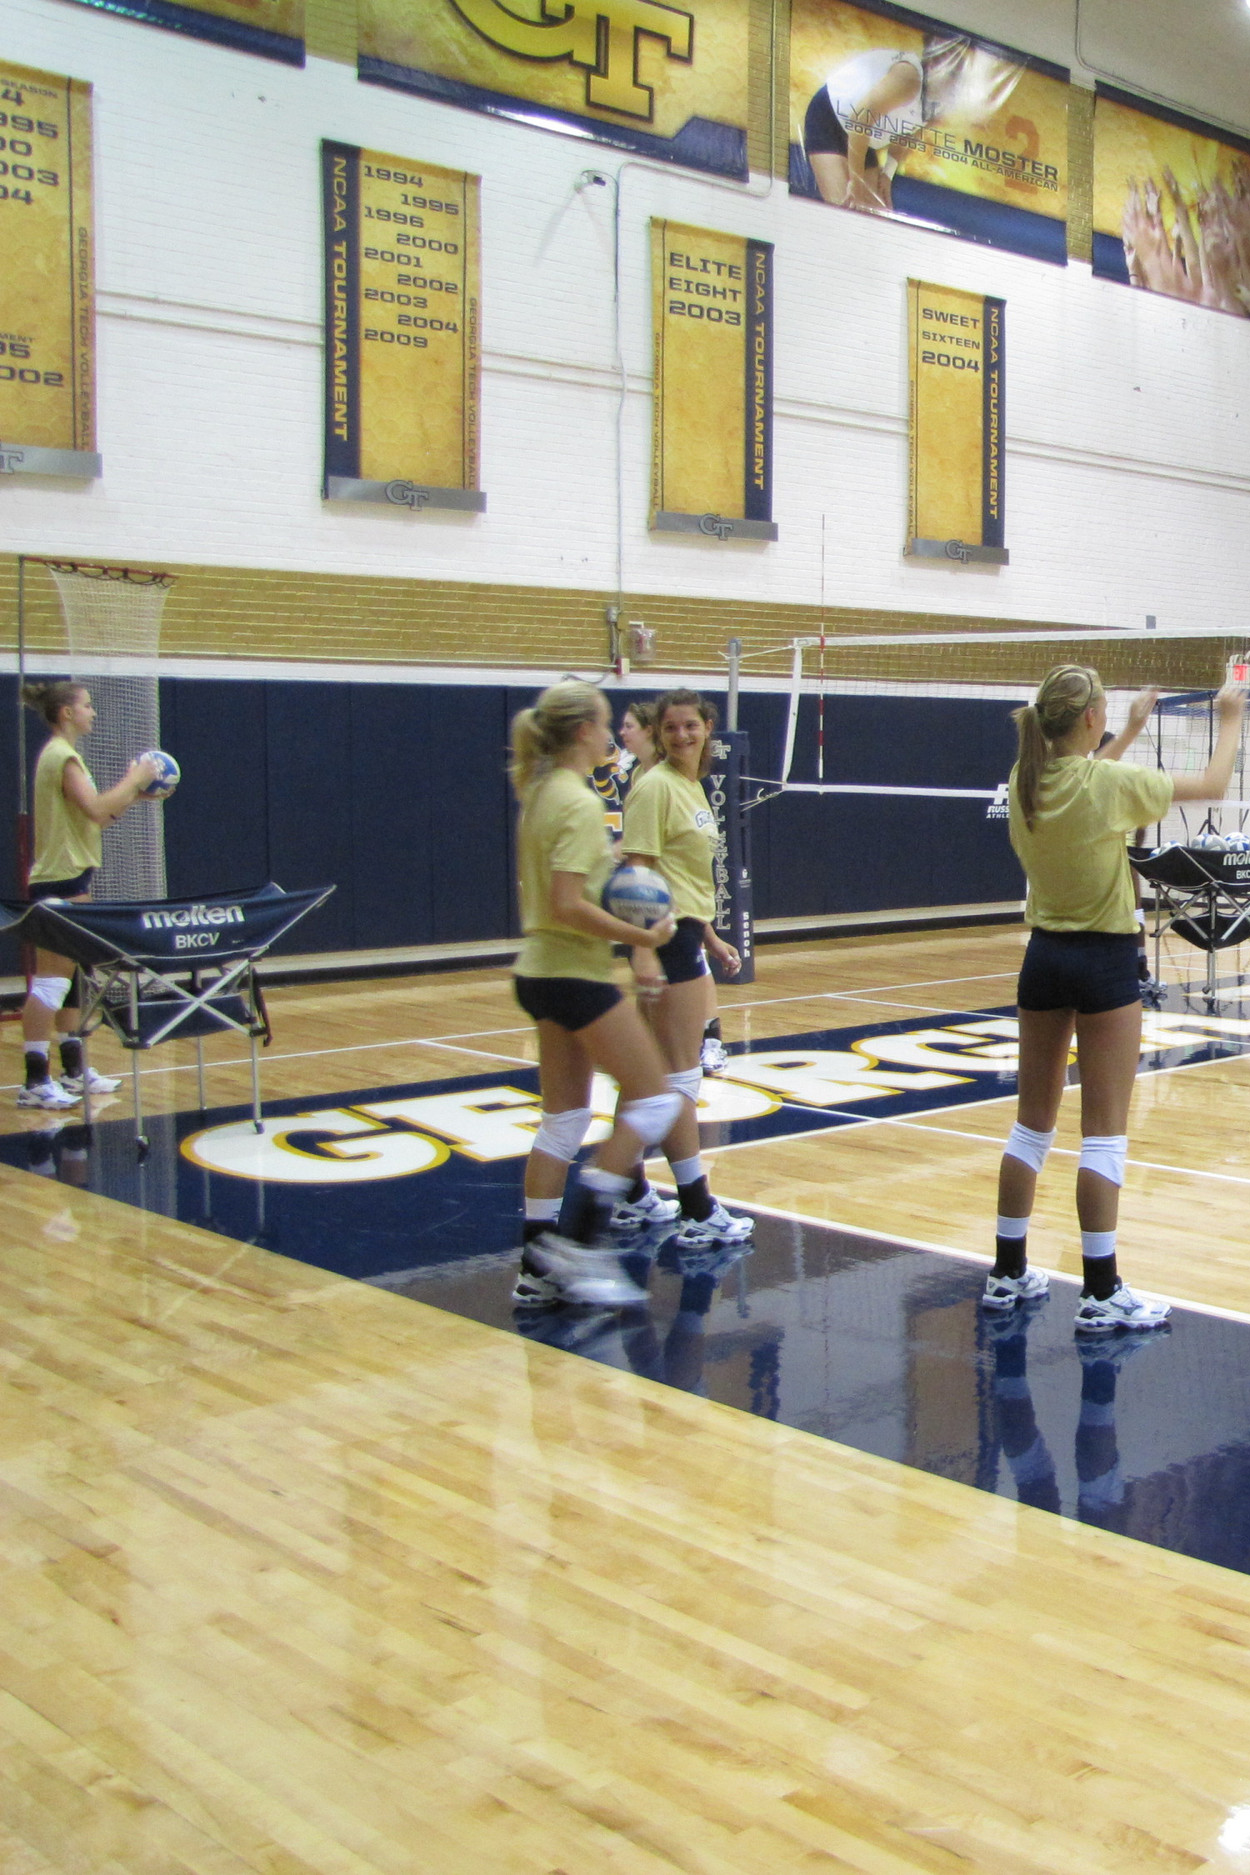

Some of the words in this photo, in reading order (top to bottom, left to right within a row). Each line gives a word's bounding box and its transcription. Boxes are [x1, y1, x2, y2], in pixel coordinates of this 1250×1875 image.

[836, 98, 957, 150] LYNNETTE
[963, 138, 1059, 181] MOSTER
[844, 121, 883, 140] 2002
[889, 135, 926, 153] 2003
[933, 149, 968, 165] 2004
[971, 159, 1059, 192] ALL-AMERICAN
[364, 165, 424, 188] 1994
[333, 156, 347, 232] NCAA
[400, 193, 460, 216] 1995
[364, 206, 425, 229] 1996
[396, 232, 459, 255] 2000
[78, 226, 89, 300] GEORGIA
[364, 247, 424, 269] 2001
[669, 252, 742, 281] ELITE
[397, 273, 459, 295] 2002
[669, 277, 742, 303] EIGHT
[755, 252, 766, 315] NCAA
[364, 288, 428, 309] 2003
[397, 314, 459, 334] 2004
[669, 300, 742, 326] 2003
[922, 307, 981, 330] SWEET
[333, 240, 348, 442] TOURNAMENT
[364, 328, 428, 349] 2009
[468, 297, 478, 360] GEORGIA
[922, 330, 981, 350] SIXTEEN
[990, 308, 999, 363] NCAA
[921, 350, 980, 373] 2004
[754, 321, 766, 490] TOURNAMENT
[989, 369, 999, 520] TOURNAMENT
[385, 478, 430, 512] GT
[699, 512, 734, 541] GT
[710, 774, 732, 930] VOLEYBALL
[142, 904, 246, 929] molten
[174, 932, 220, 949] BKCV
